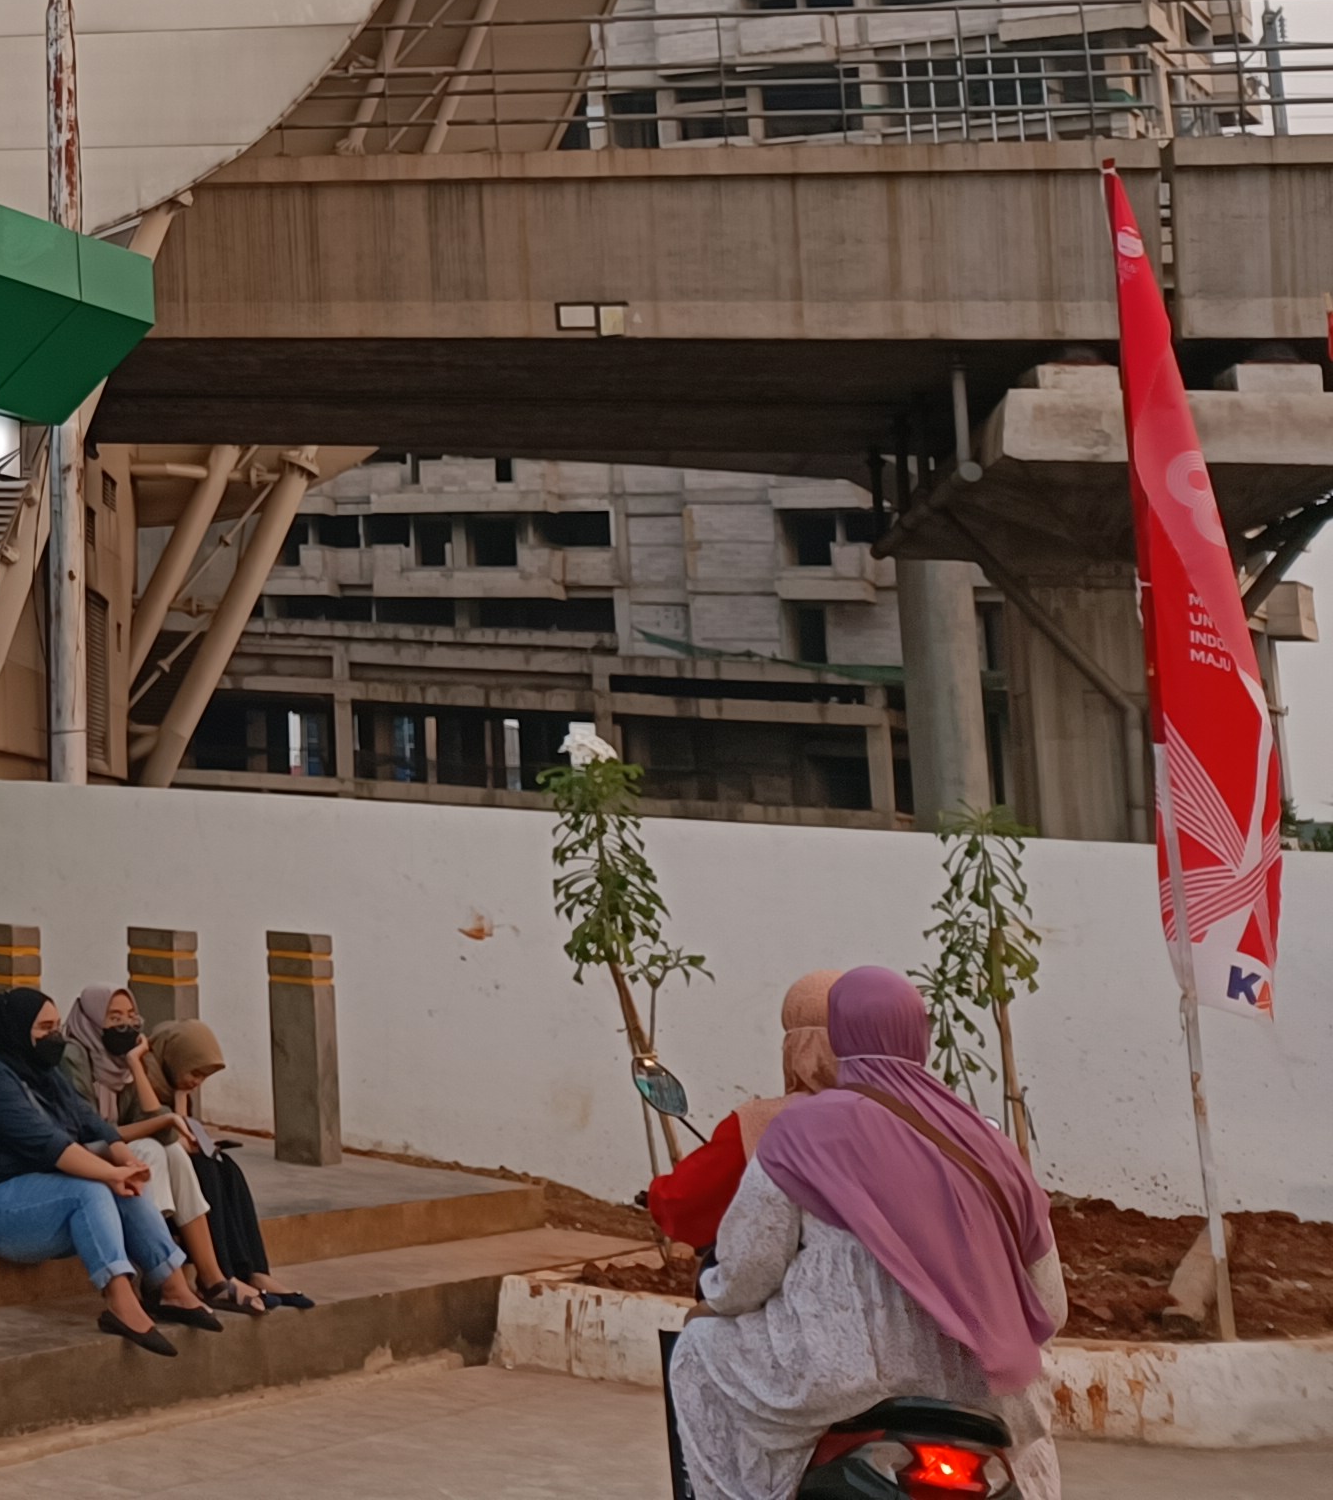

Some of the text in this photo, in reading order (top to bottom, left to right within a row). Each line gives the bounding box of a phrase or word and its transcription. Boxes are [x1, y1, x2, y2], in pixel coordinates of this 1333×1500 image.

[1188, 629, 1226, 652] INDO
[1189, 648, 1232, 672] MAJU
[1226, 964, 1275, 1023] KA
